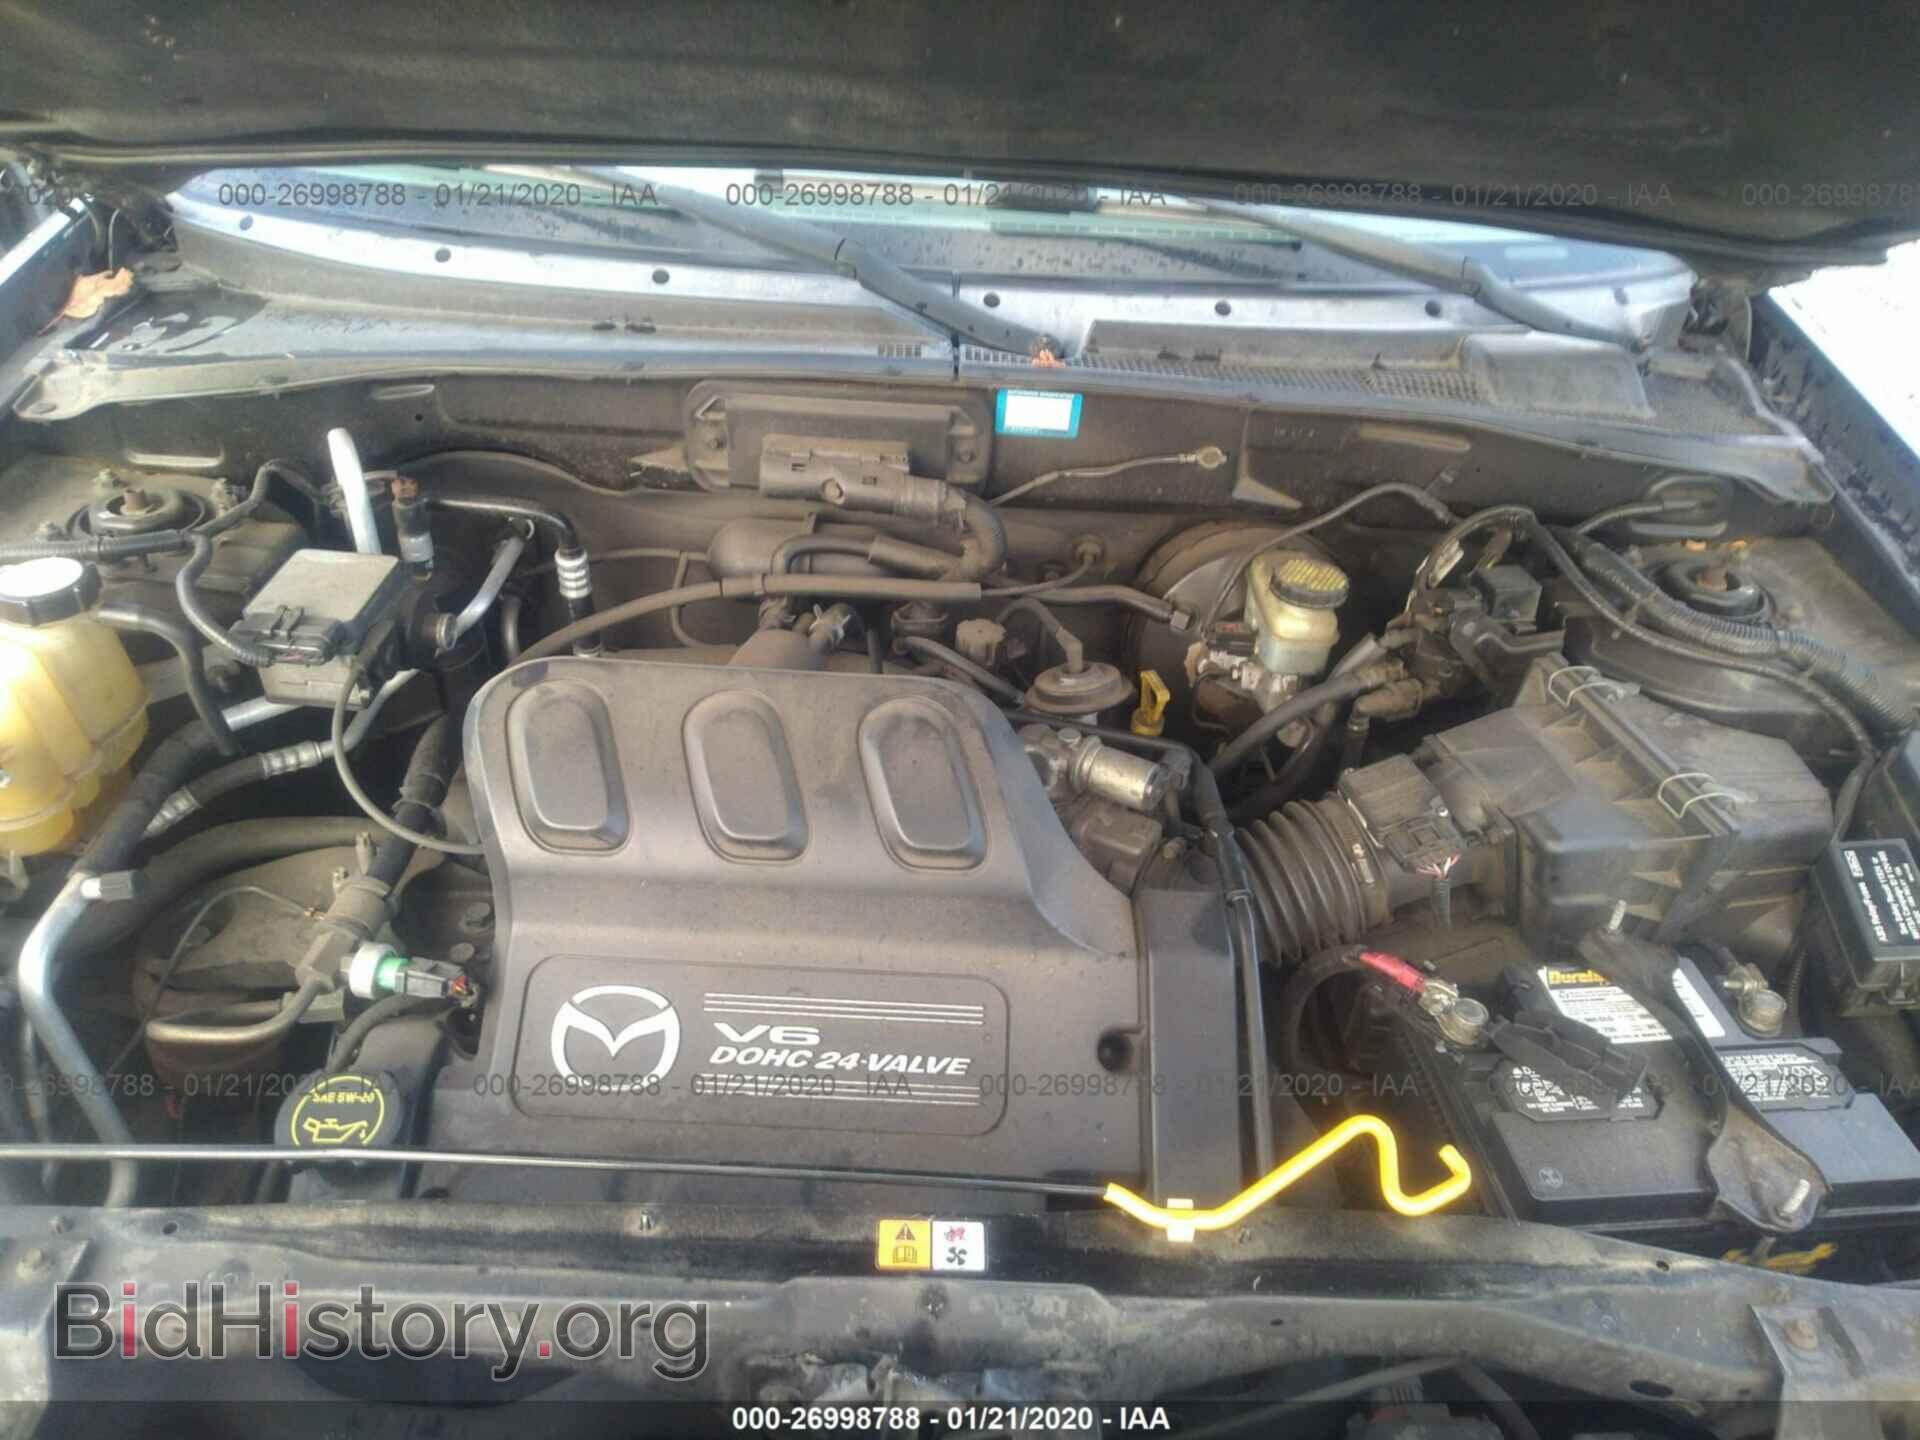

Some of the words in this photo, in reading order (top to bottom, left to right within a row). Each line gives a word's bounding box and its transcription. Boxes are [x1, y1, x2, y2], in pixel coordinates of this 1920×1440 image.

[1548, 968, 1611, 986] Durala
[712, 1021, 822, 1045] V6
[710, 1046, 814, 1069] DOHC
[817, 1050, 971, 1076] 24-VALVE
